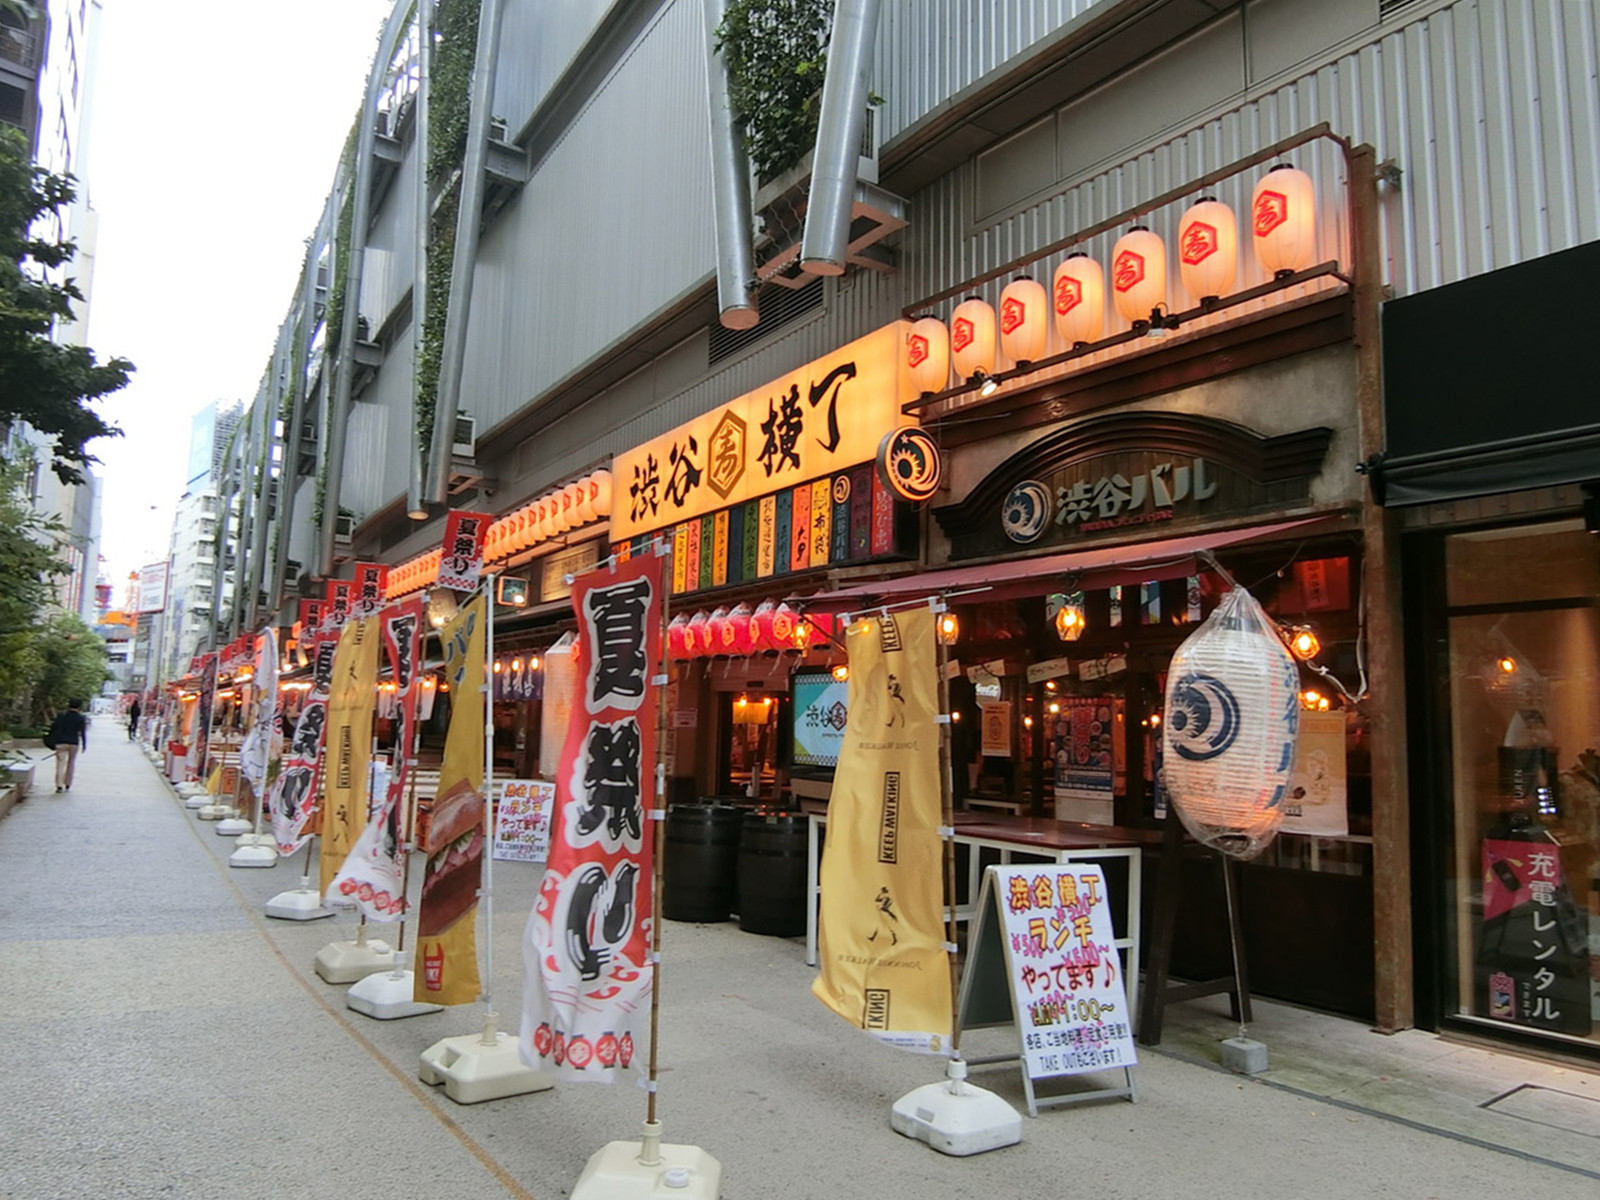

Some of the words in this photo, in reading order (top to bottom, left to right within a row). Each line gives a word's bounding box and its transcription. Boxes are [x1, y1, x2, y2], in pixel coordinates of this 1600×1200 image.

[1055, 457, 1218, 526] 渋谷バル
[453, 518, 480, 576] 夏祭り
[333, 584, 350, 625] 夏祭り
[362, 568, 380, 613] 夏祭り
[1009, 873, 1100, 910] 渋谷横丁
[1028, 915, 1093, 951] ランチ
[1527, 852, 1560, 1020] 充電レンタル
